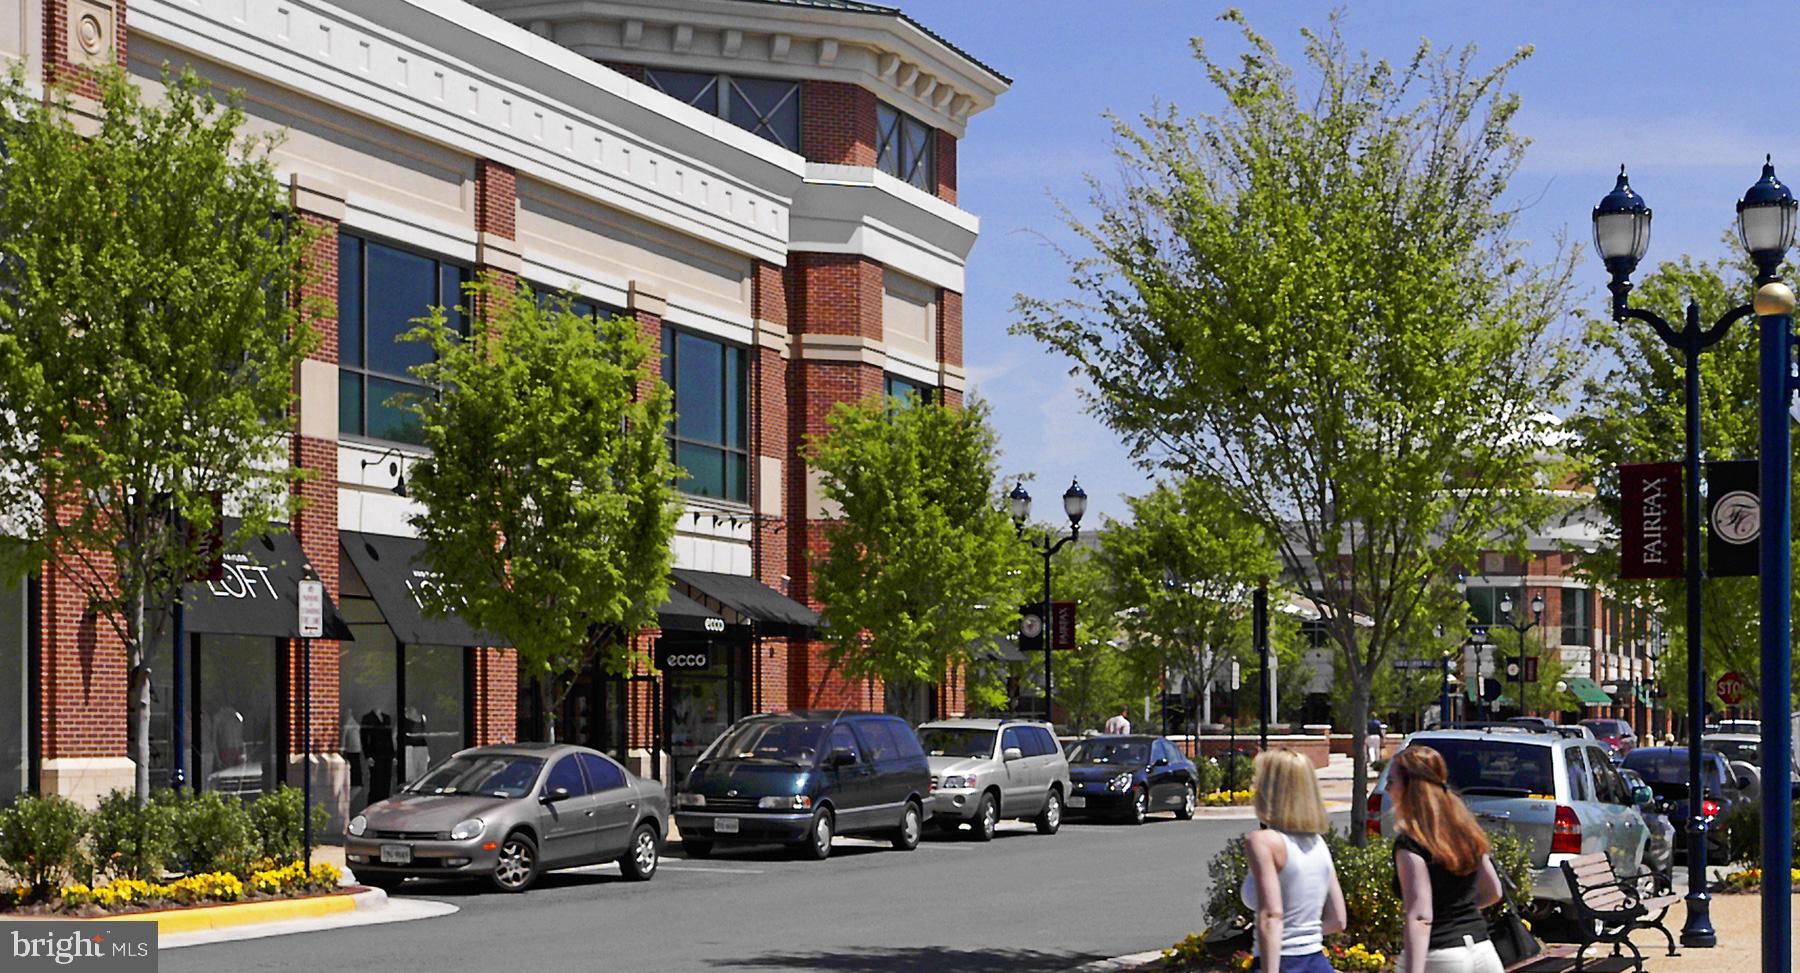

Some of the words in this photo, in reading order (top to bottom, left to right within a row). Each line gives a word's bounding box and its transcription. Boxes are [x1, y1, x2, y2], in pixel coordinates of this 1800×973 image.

[1642, 478, 1662, 564] FAIRFAX
[704, 617, 725, 632] ecco
[666, 654, 706, 667] ecco
[1718, 681, 1745, 695] STO
